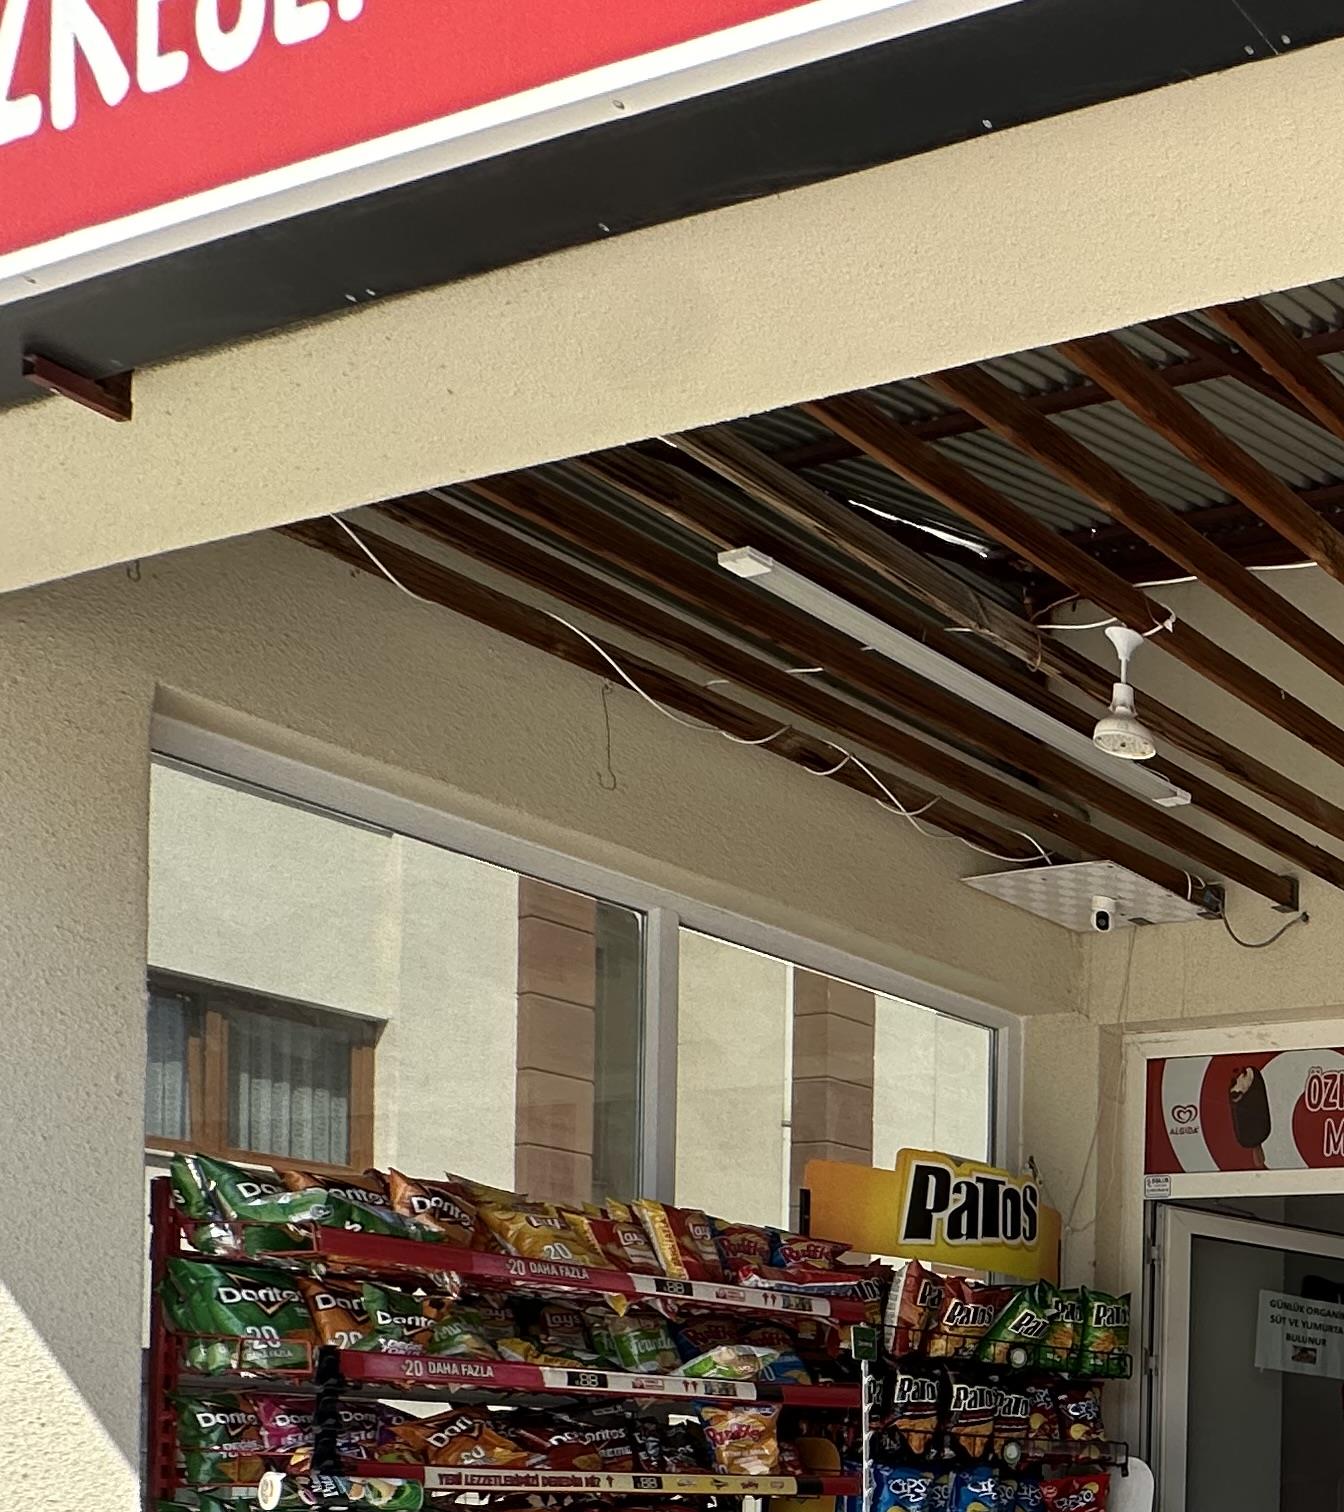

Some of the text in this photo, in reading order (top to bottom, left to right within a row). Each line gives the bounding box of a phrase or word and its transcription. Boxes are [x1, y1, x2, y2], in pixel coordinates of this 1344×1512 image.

[529, 1263, 558, 1279] DAHA
[558, 1265, 590, 1281] FAZLA
[1270, 1299, 1305, 1313] GÜNLÜK
[1270, 1315, 1344, 1334] SÜT VE YUMURTA
[1286, 1333, 1327, 1346] BULUNUR
[428, 1361, 459, 1376] DAHA
[461, 1363, 494, 1378] FAZLA
